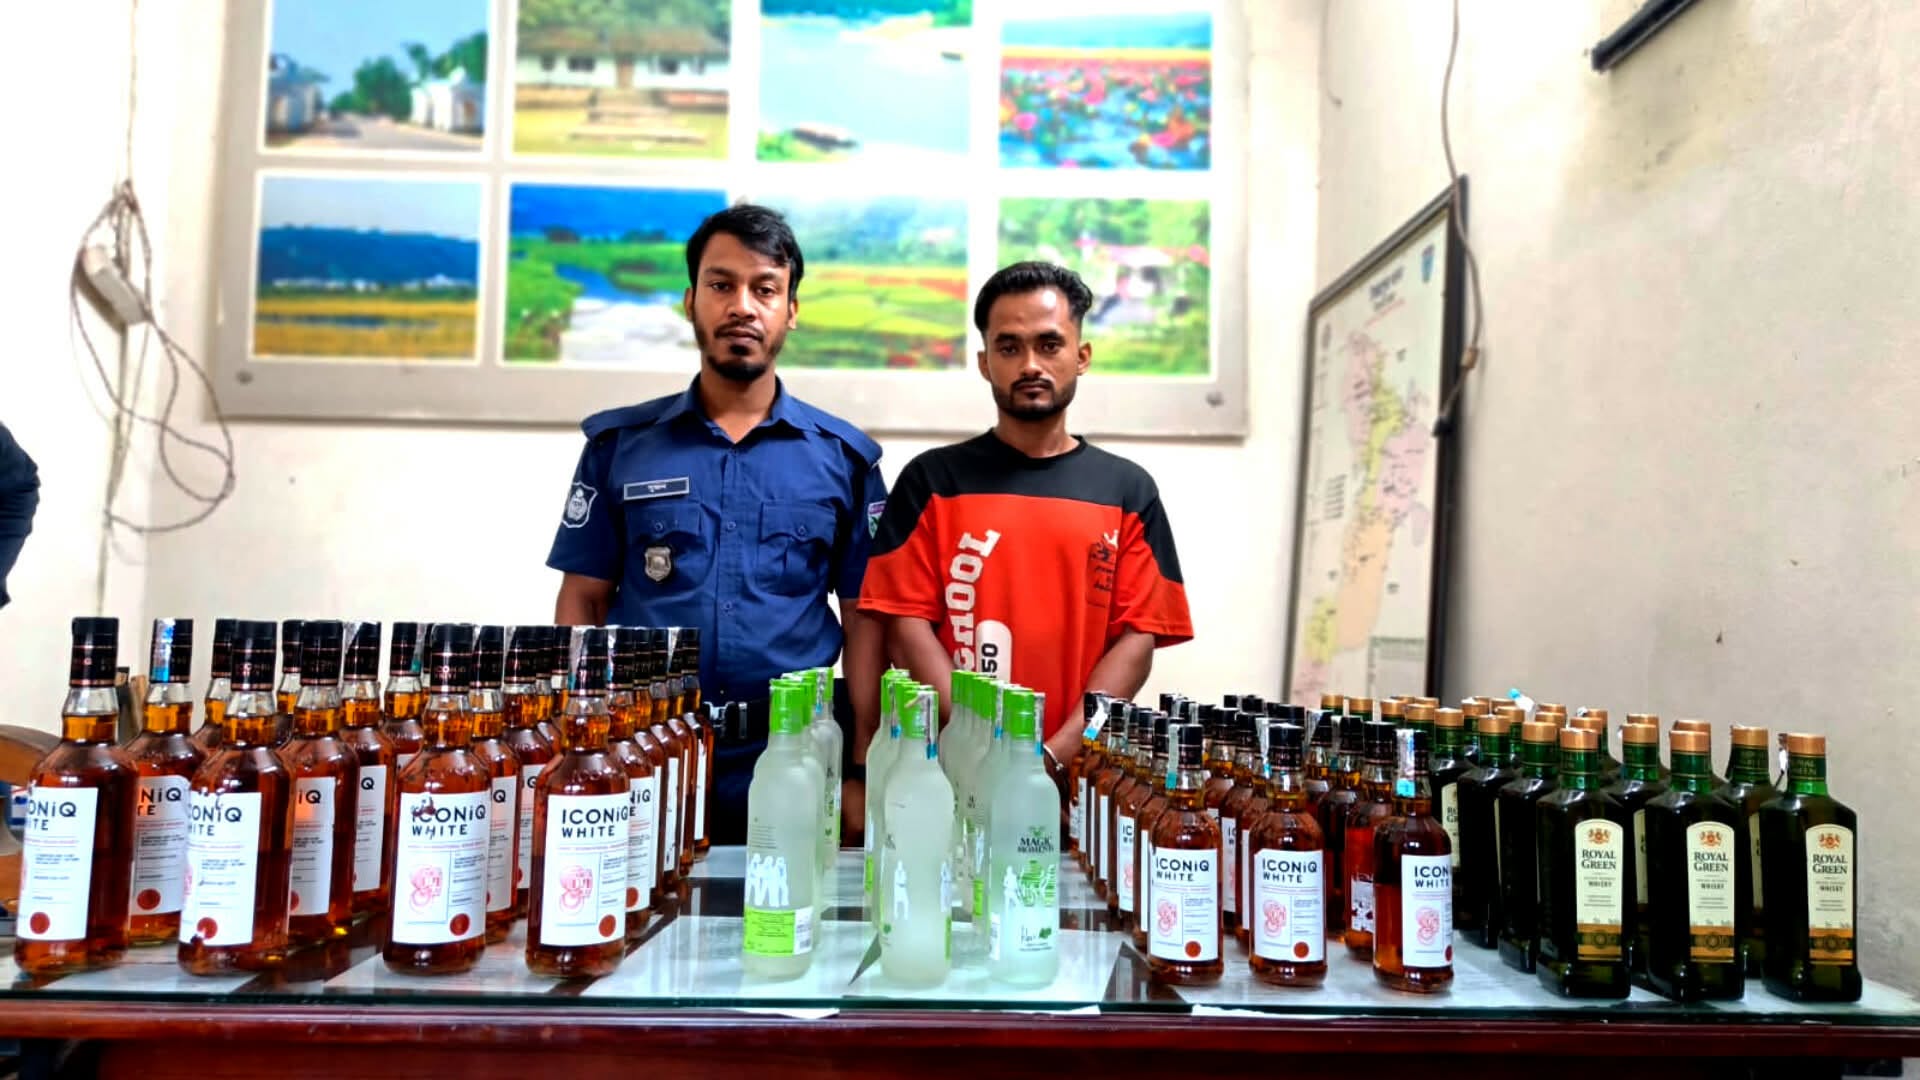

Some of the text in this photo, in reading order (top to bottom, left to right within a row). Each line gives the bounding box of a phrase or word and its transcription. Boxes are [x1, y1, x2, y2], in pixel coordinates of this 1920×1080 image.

[945, 529, 1001, 671] CHOOL
[981, 643, 999, 679] 50
[141, 787, 182, 803] NiQ
[28, 799, 77, 818] ONiQ
[188, 804, 242, 822] ONiQ
[412, 824, 468, 837] WHITE
[562, 825, 615, 838] WHITE
[1582, 849, 1617, 860] ROYAL
[1693, 851, 1729, 862] ROYAL
[1812, 853, 1848, 864] ROYAL
[1581, 859, 1617, 870] GREEN
[1693, 862, 1729, 872] GREEN
[1812, 863, 1848, 874] GREEN
[1156, 871, 1194, 882] WHITE
[1263, 871, 1303, 884] WHITE
[1414, 865, 1449, 878] ICON
